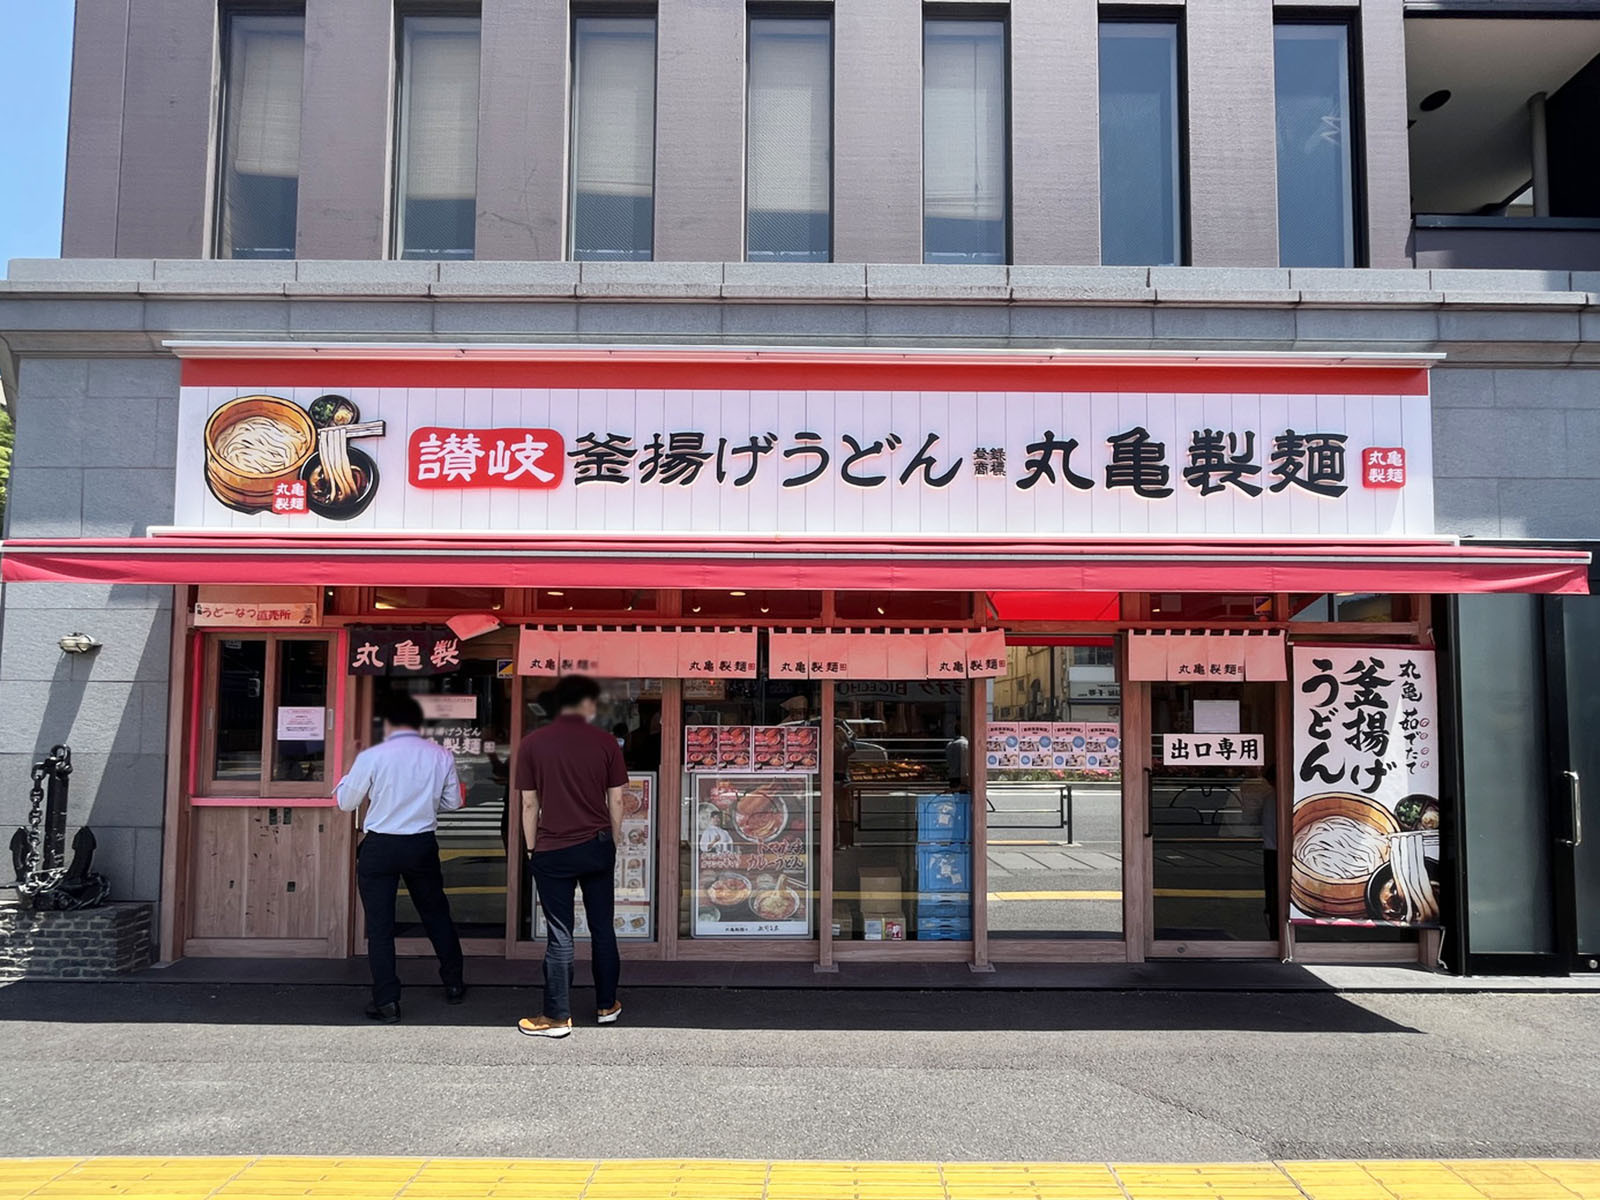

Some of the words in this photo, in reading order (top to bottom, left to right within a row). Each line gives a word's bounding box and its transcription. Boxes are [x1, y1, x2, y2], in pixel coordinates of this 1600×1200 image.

[417, 433, 556, 483] 讃岐
[567, 432, 963, 487] 釜揚げうどん
[1016, 426, 1349, 498] 丸亀製麺
[1368, 451, 1403, 466] 丸亀
[1368, 468, 1403, 483] 製麺
[275, 483, 304, 496] 丸亀
[352, 638, 460, 670] 丸亀製
[689, 660, 747, 672] 丸亀製麺
[781, 661, 839, 673] 丸亀製麺
[939, 659, 998, 673] 丸亀製麺
[1178, 663, 1237, 675] 丸亀製麺
[1398, 660, 1422, 702] 丸亀
[1300, 659, 1346, 784] うどん
[1340, 656, 1397, 794] 釜揚げ
[1170, 737, 1258, 761] 出口専用
[1398, 707, 1421, 775] 茹でたて
